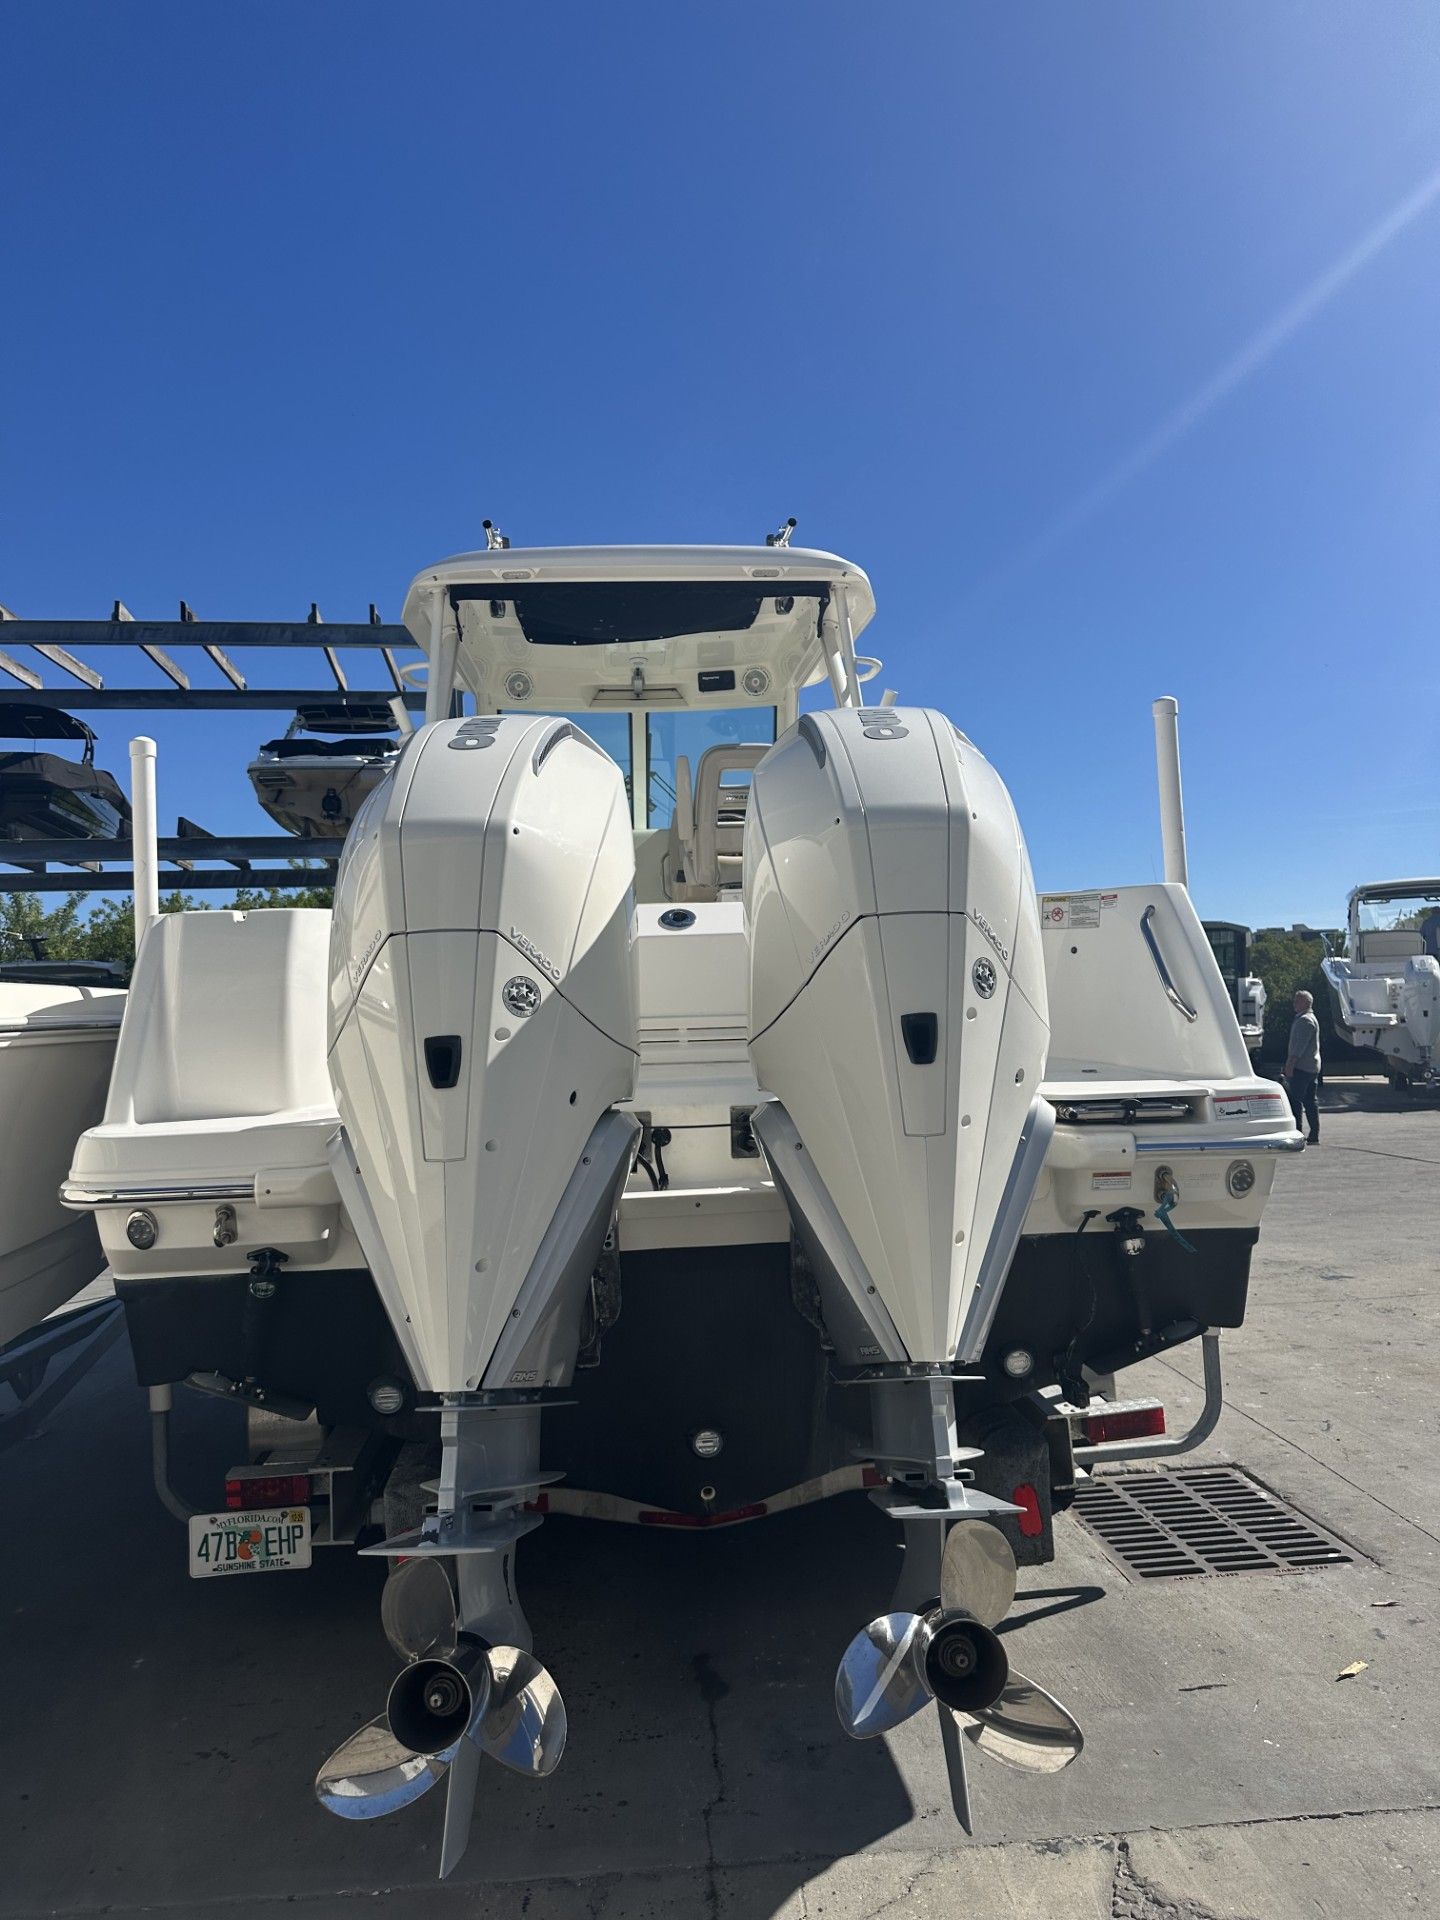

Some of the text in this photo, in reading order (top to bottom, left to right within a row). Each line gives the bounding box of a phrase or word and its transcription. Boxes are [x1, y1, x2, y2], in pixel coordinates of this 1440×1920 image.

[264, 1525, 304, 1557] EHP
[217, 1557, 285, 1572] SUNSHINE STATE
